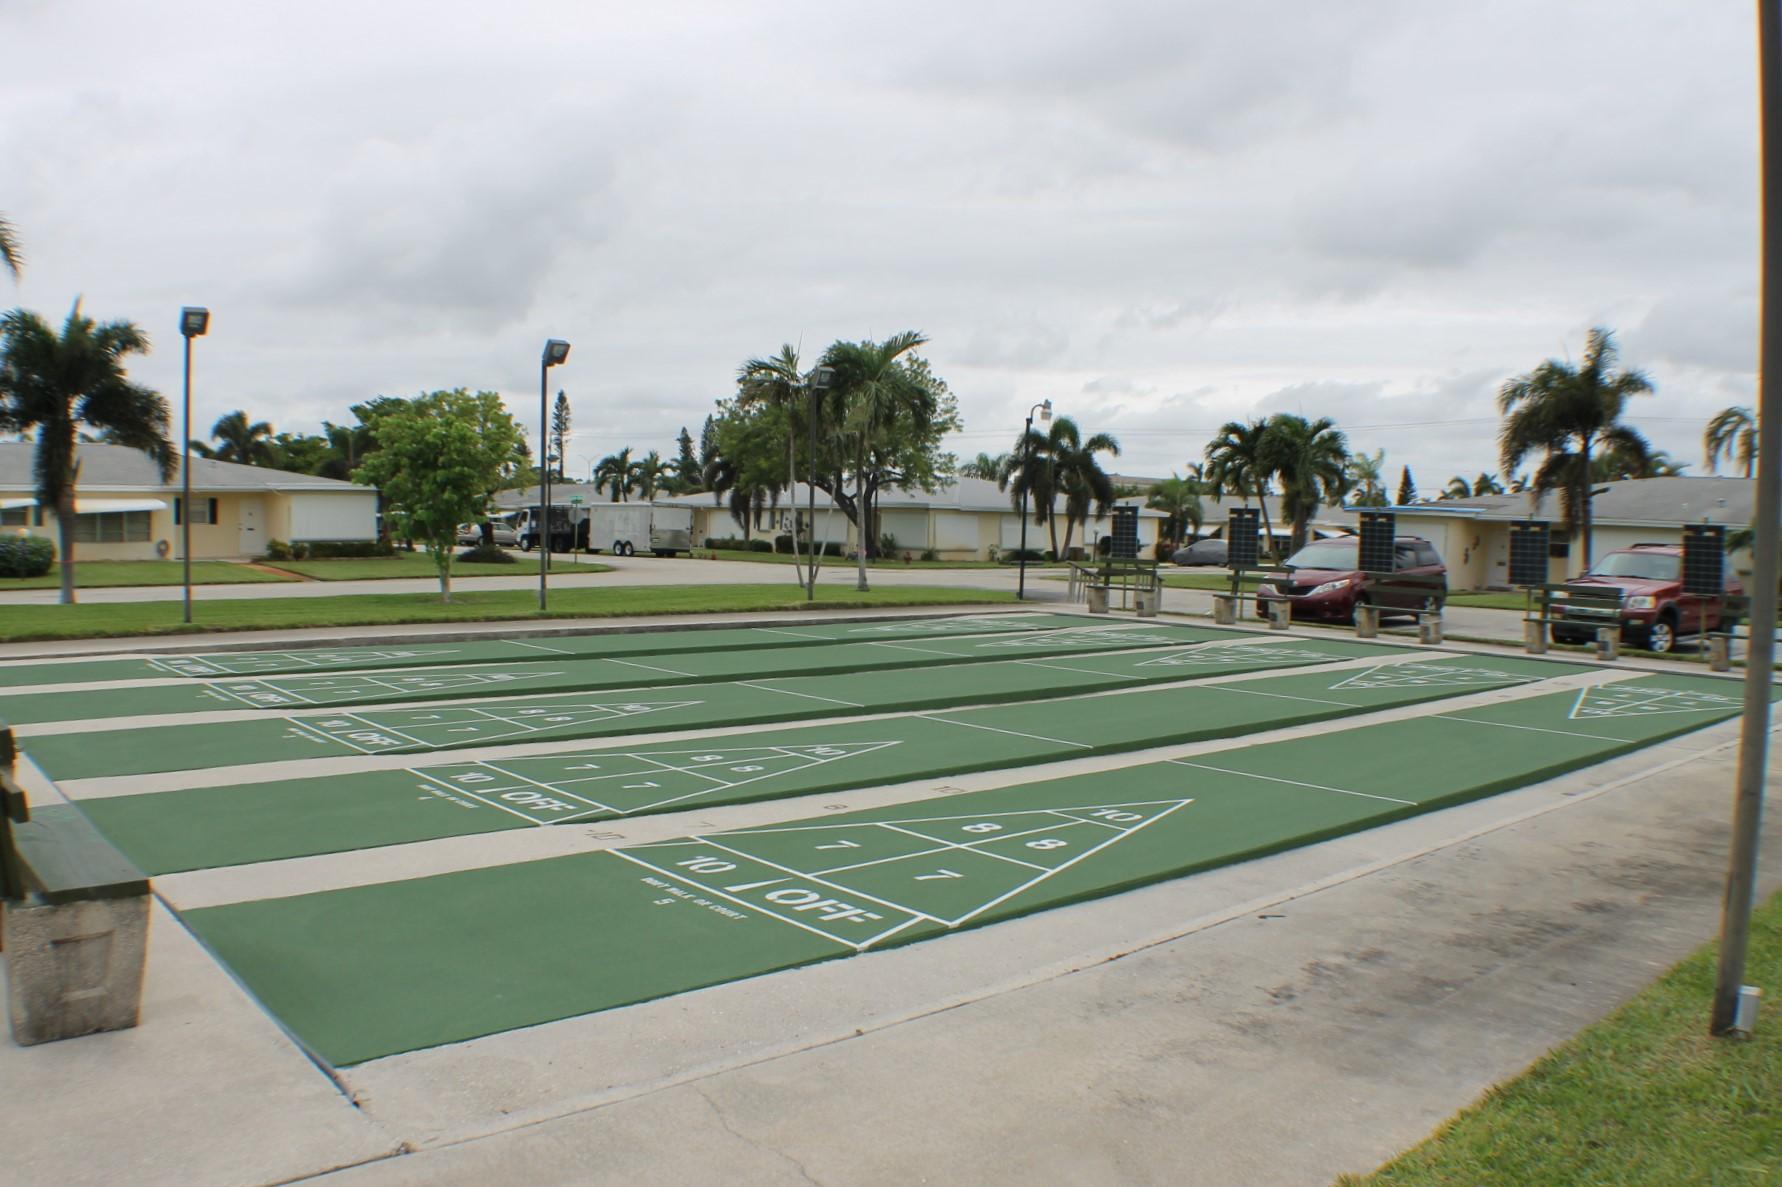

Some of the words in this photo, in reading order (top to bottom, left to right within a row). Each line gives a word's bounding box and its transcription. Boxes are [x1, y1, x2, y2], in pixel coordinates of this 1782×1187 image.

[806, 746, 846, 756] 10
[690, 754, 724, 762] 8
[730, 764, 765, 773] 8
[450, 772, 495, 783] 10
[621, 781, 661, 789] 7
[501, 791, 577, 811] OFF
[1089, 808, 1143, 822] 10
[961, 822, 1003, 833] 8
[814, 839, 862, 850] 7
[1025, 838, 1068, 850] 8
[675, 855, 737, 874] 10
[913, 868, 964, 880] 7
[764, 888, 884, 923] OFF
